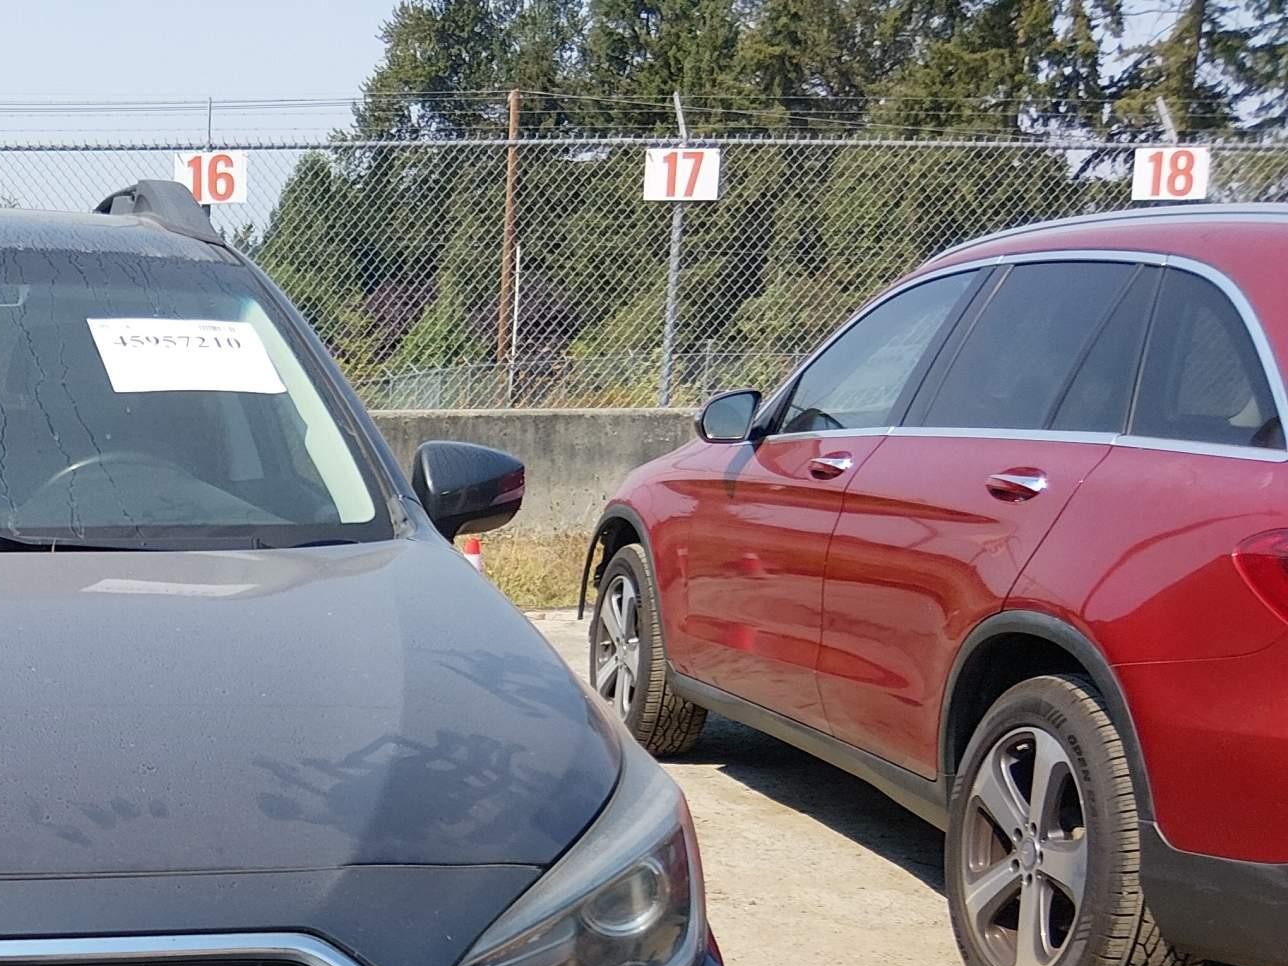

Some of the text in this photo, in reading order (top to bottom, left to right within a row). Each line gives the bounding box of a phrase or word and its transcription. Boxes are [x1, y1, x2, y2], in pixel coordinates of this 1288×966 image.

[187, 154, 235, 202] 16
[663, 151, 704, 197] 17
[1148, 150, 1194, 196] 18
